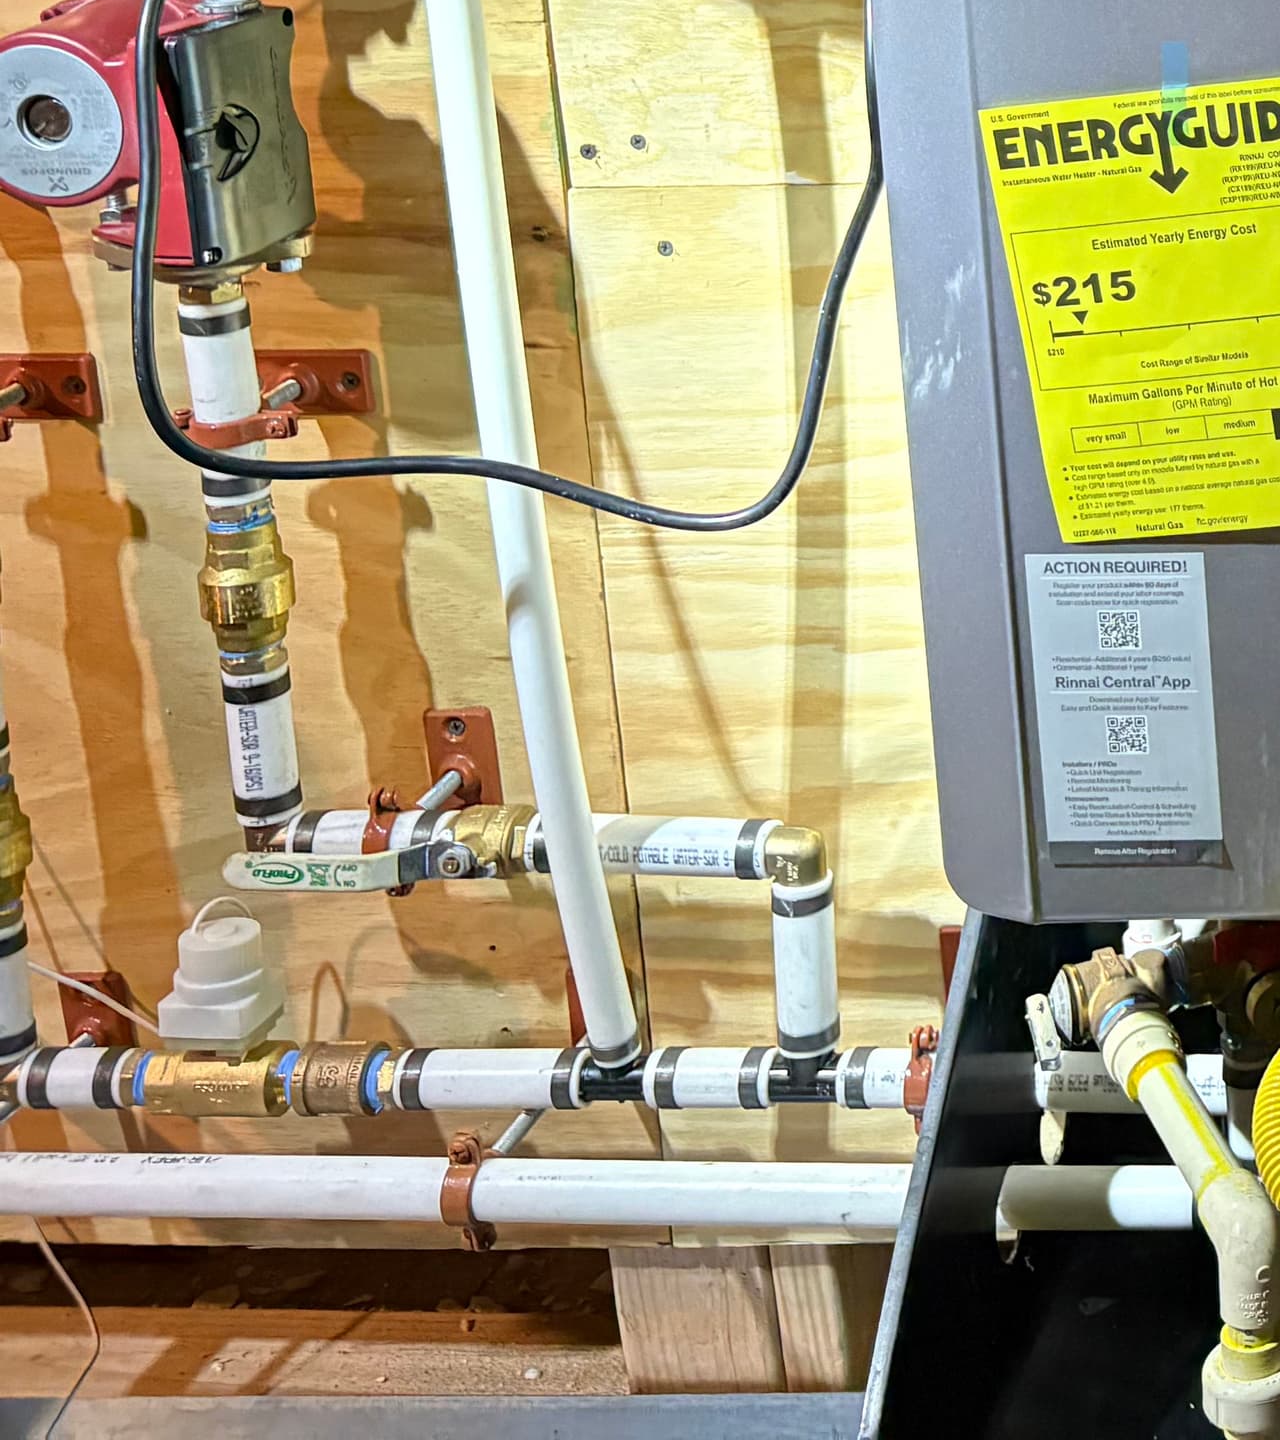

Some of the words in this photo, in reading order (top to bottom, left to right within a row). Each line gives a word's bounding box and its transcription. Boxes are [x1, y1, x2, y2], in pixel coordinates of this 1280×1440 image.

[1006, 109, 1049, 121] Government
[1101, 167, 1127, 176] Natural
[1128, 165, 1142, 174] Gas
[1091, 233, 1147, 250] Estimated
[1149, 229, 1185, 245] Yearly
[1187, 225, 1228, 241] Energy
[1229, 222, 1257, 235] Cost
[1030, 269, 1137, 309] $215
[1140, 359, 1158, 369] Cost
[1088, 389, 1139, 404] Maximum
[1141, 385, 1183, 399] Gallons
[1185, 382, 1206, 395] Per
[1209, 379, 1243, 393] Minute
[1244, 378, 1256, 390] of
[1258, 375, 1280, 388] Hot
[1171, 398, 1198, 411] (GPM
[1199, 395, 1232, 409] Rating)
[1222, 418, 1256, 429] medium
[1104, 430, 1127, 440] small
[1165, 426, 1180, 435] low
[1135, 521, 1164, 533] Natural
[1165, 519, 1184, 530] Gas
[1043, 561, 1100, 574] ACTION
[1103, 560, 1187, 573] REQUIRED!
[1054, 676, 1099, 688] Rinnai
[1161, 675, 1191, 689] App
[341, 864, 357, 872] OFF
[343, 880, 356, 888] ON
